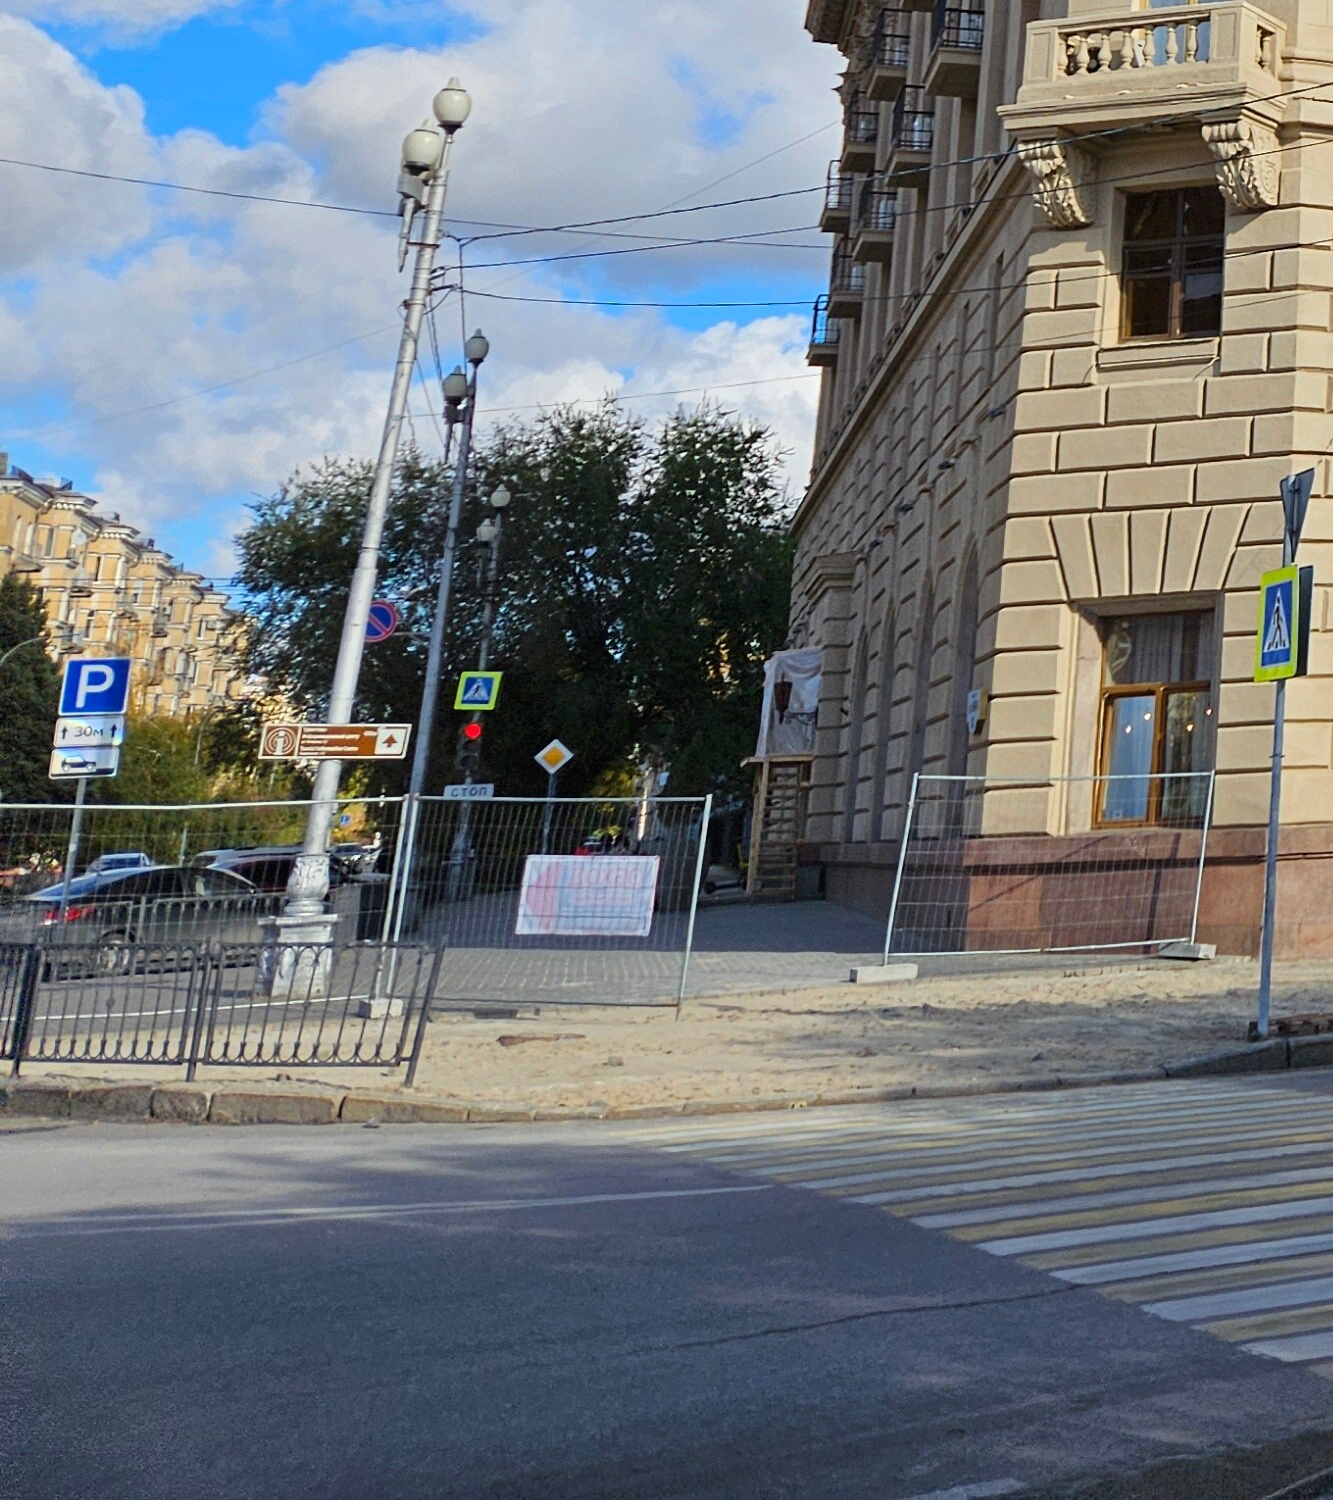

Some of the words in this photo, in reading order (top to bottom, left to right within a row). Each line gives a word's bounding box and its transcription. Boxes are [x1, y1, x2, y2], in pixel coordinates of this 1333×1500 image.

[75, 664, 115, 709] P
[73, 725, 104, 738] 30м
[450, 786, 488, 797] СТОП
